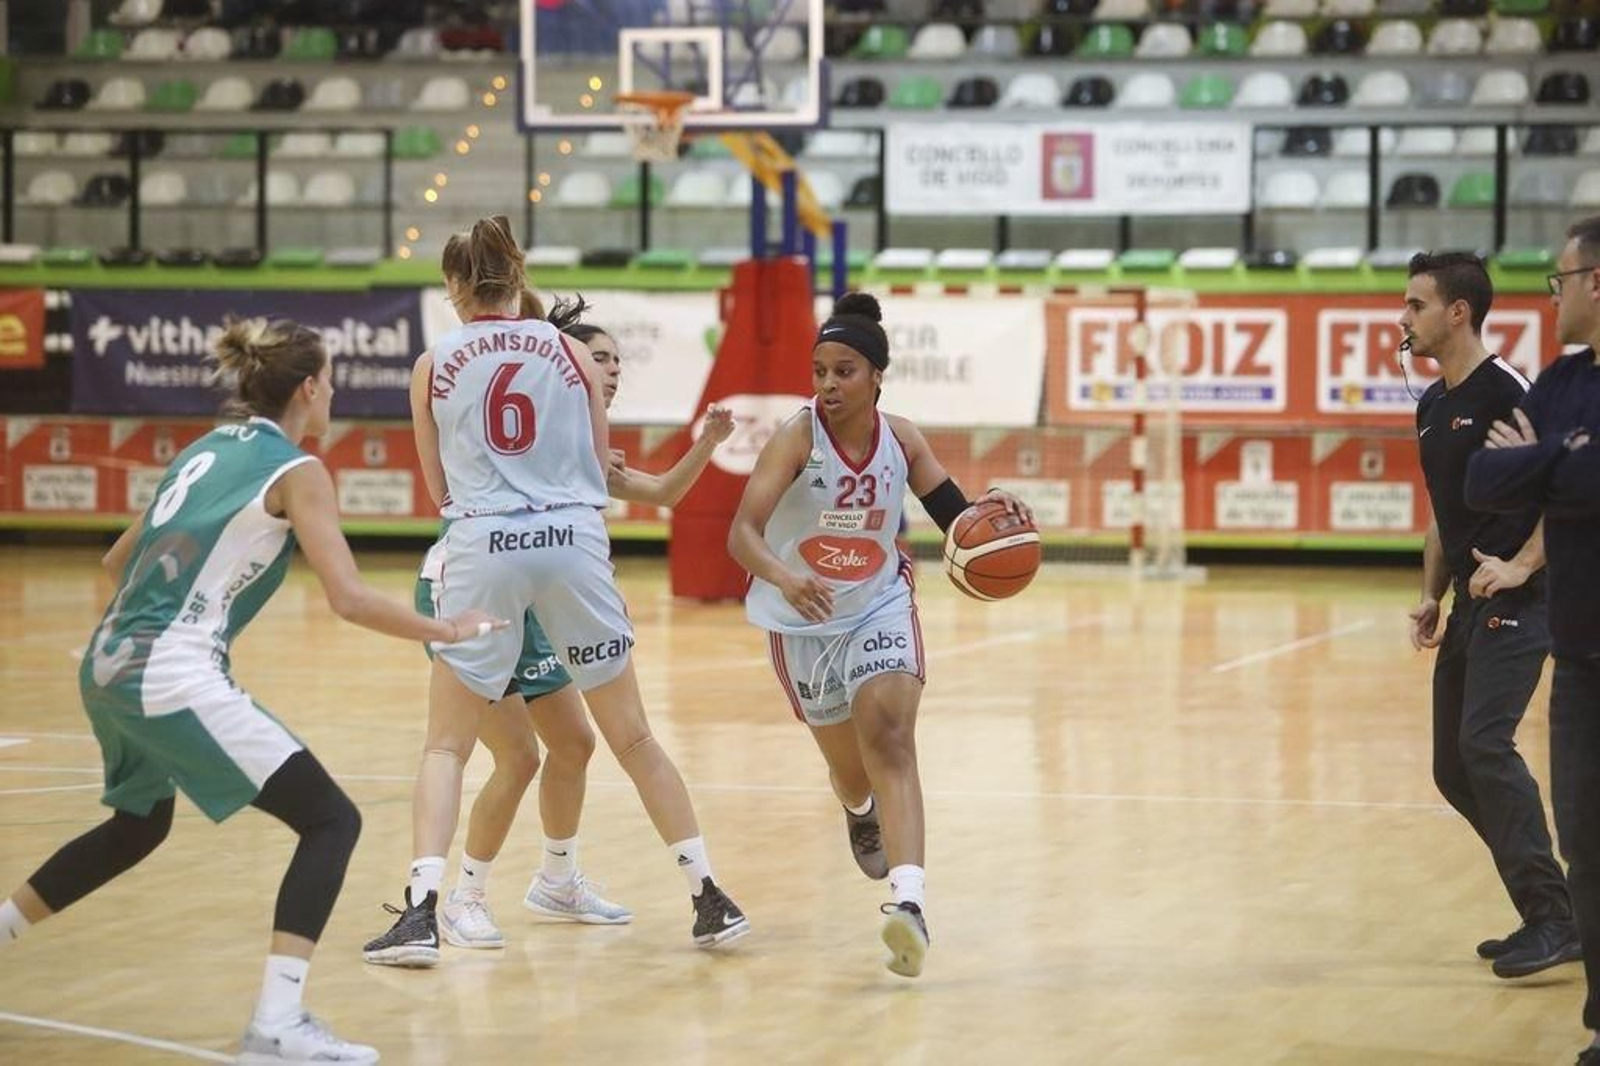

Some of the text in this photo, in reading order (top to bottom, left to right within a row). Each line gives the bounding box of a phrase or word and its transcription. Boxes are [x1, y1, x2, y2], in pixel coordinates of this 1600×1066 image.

[483, 361, 537, 457] 6
[151, 451, 216, 528] 8
[836, 474, 877, 509] 23
[823, 512, 863, 521] CONCELLO
[488, 524, 574, 554] Recalvi
[567, 634, 634, 666] Recalv
[863, 631, 907, 652] abc
[850, 658, 907, 681] ABANCA
